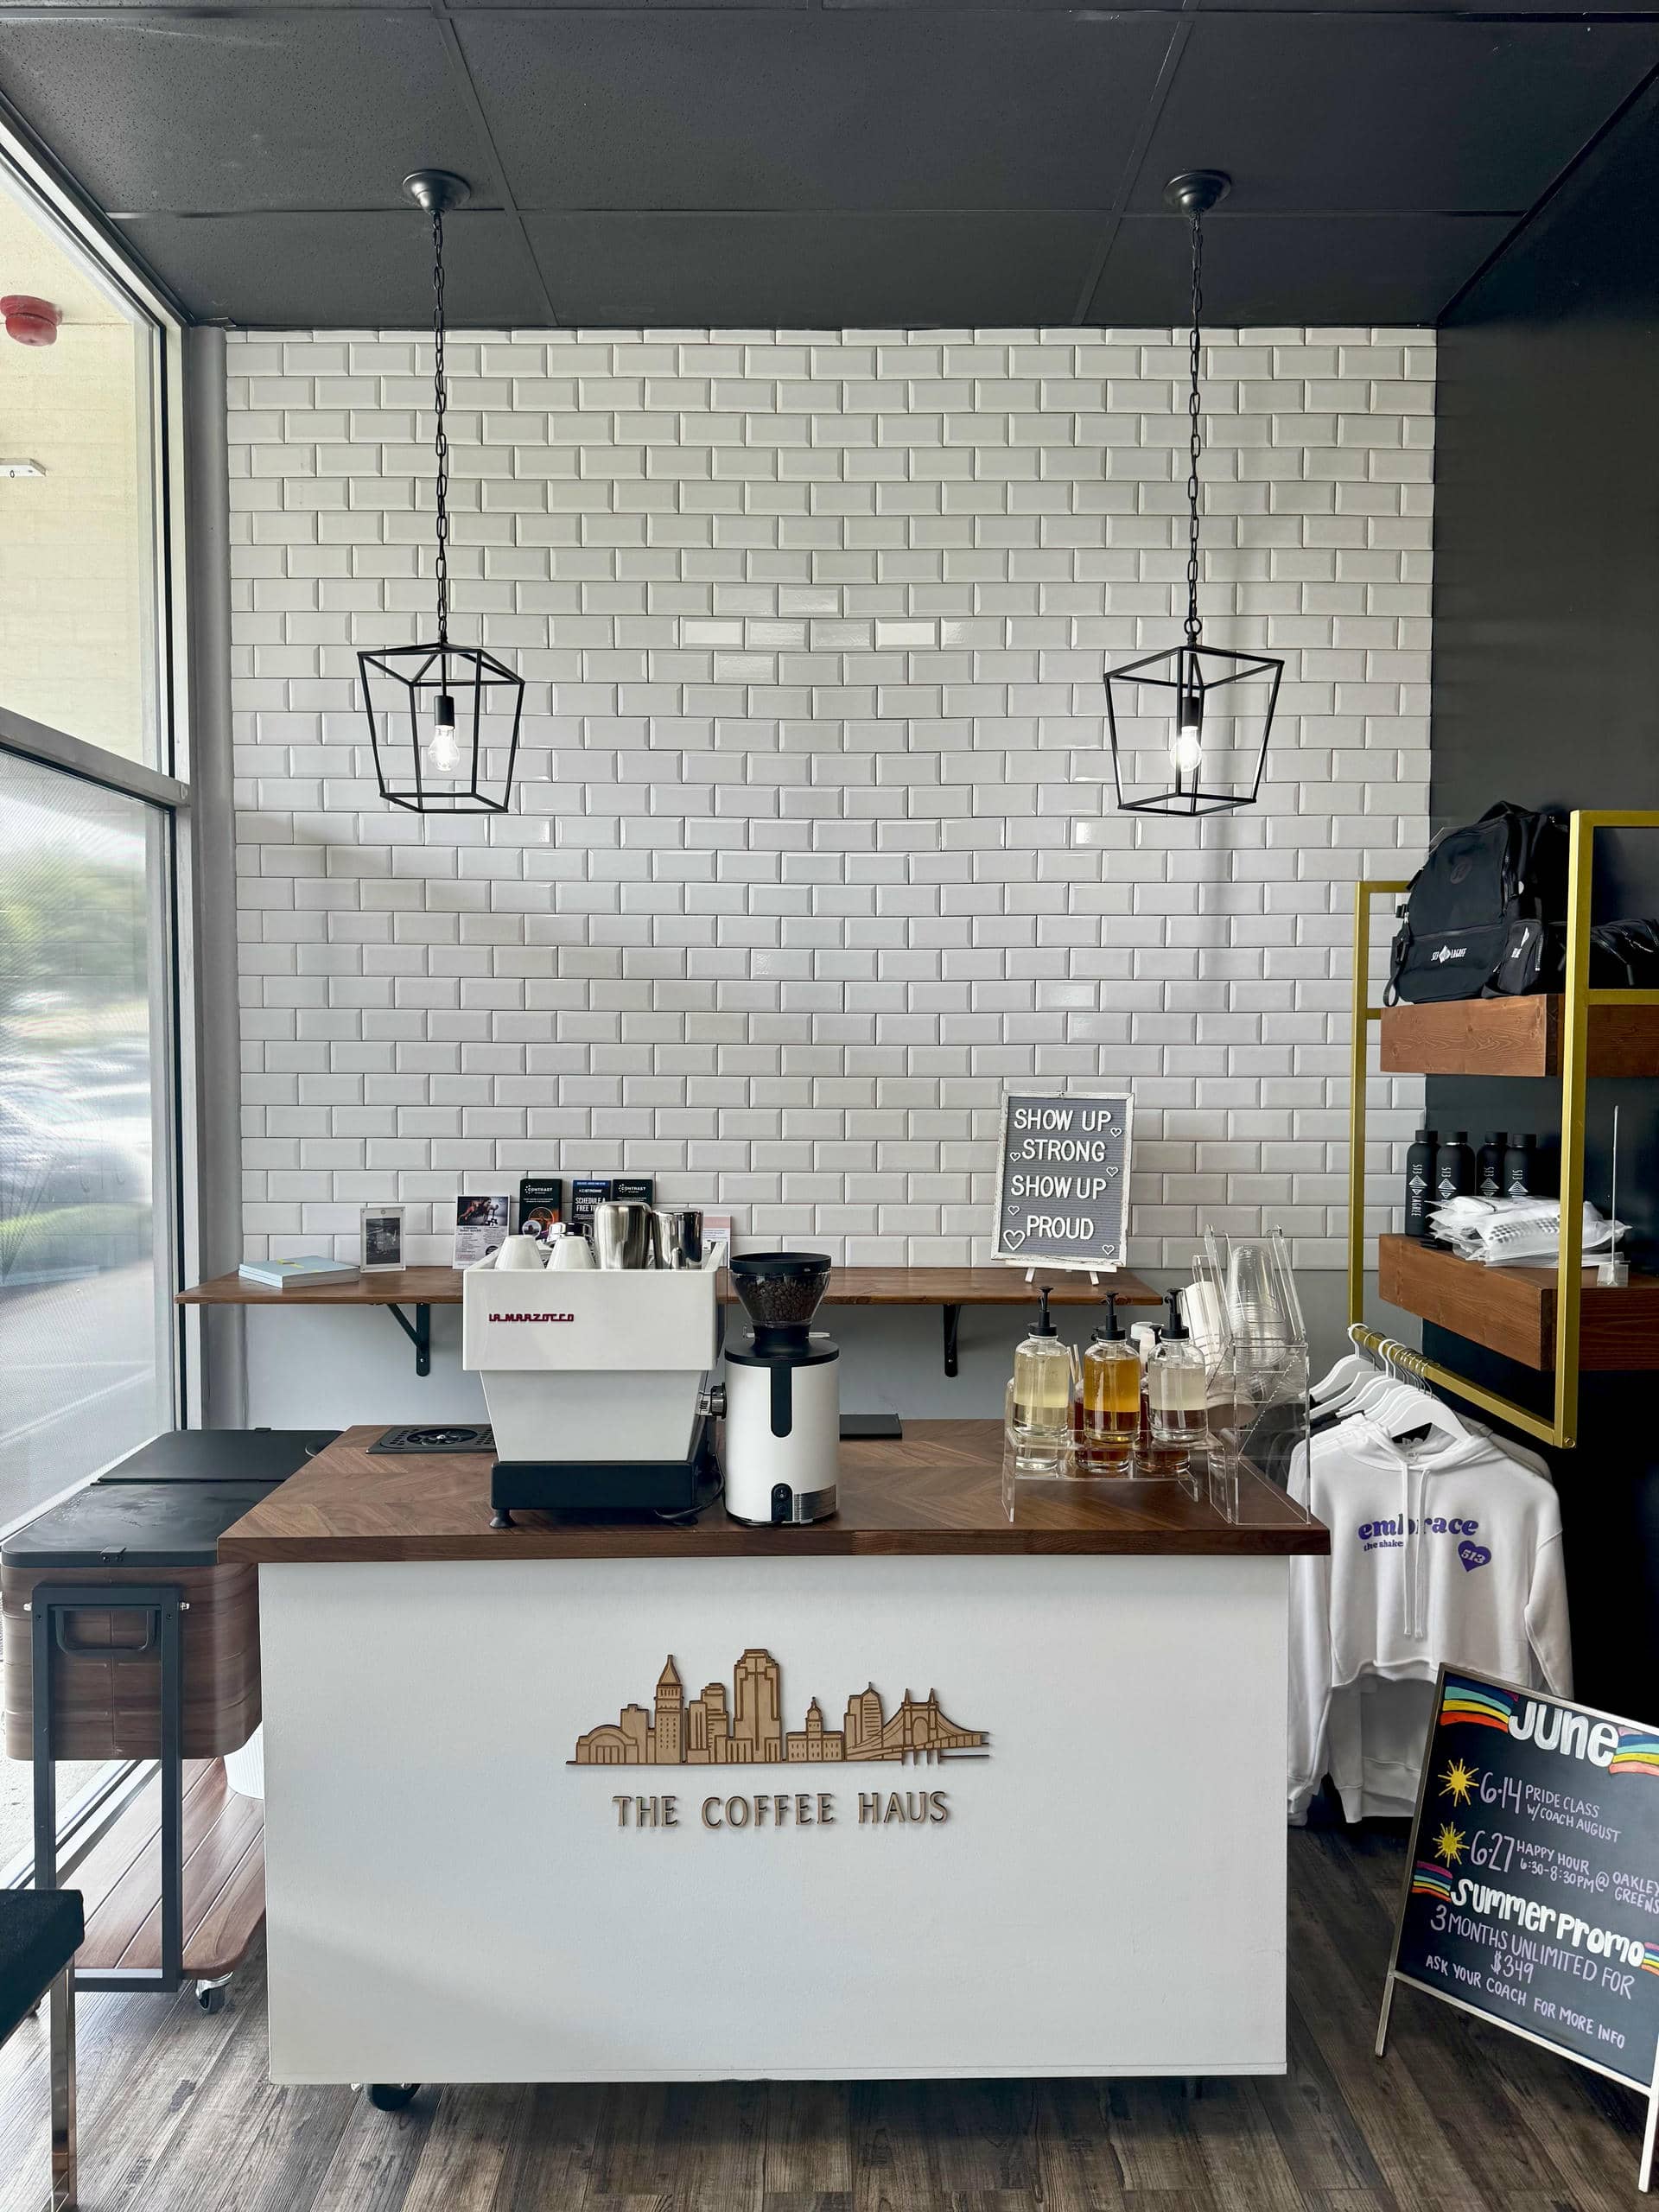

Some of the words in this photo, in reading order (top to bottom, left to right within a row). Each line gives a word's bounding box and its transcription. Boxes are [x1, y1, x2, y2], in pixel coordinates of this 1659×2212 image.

[1014, 1108, 1074, 1131] SHOW
[1082, 1110, 1112, 1132] UP
[1022, 1139, 1106, 1162] STRONG
[1010, 1174, 1072, 1198] SHOW
[1077, 1178, 1107, 1199] UP
[1411, 1195, 1422, 1217] LAGREE
[1027, 1215, 1095, 1240] PROUD
[505, 1313, 575, 1322] MARZOCCO
[1363, 1541, 1378, 1552] the
[1461, 1548, 1486, 1564] 513
[612, 1796, 678, 1827] THE
[701, 1792, 835, 1829] COFFEE
[857, 1790, 949, 1824] HAUS
[1525, 1784, 1560, 1808] PRIDE
[1563, 1796, 1600, 1818] CLASS
[1575, 1818, 1622, 1843] AUGUST
[1516, 1840, 1555, 1862] HAPPY
[1557, 1853, 1590, 1875] HOUR
[1595, 1871, 1610, 1892] @
[1614, 1886, 1659, 1914] GREENS
[1430, 1904, 1447, 1931] 3
[1448, 1913, 1507, 1950] MONTHS
[1511, 1934, 1598, 1981] UNLIMITED
[1601, 1967, 1635, 1999] FOR
[1491, 1950, 1535, 1984] $349
[1425, 1955, 1448, 1976] ASK
[1452, 1963, 1482, 1988] YOUR
[1486, 1977, 1527, 2006] COACH
[1534, 1997, 1556, 2019] FOR
[1559, 2006, 1594, 2035] MORE
[1598, 2024, 1625, 2049] INFO
